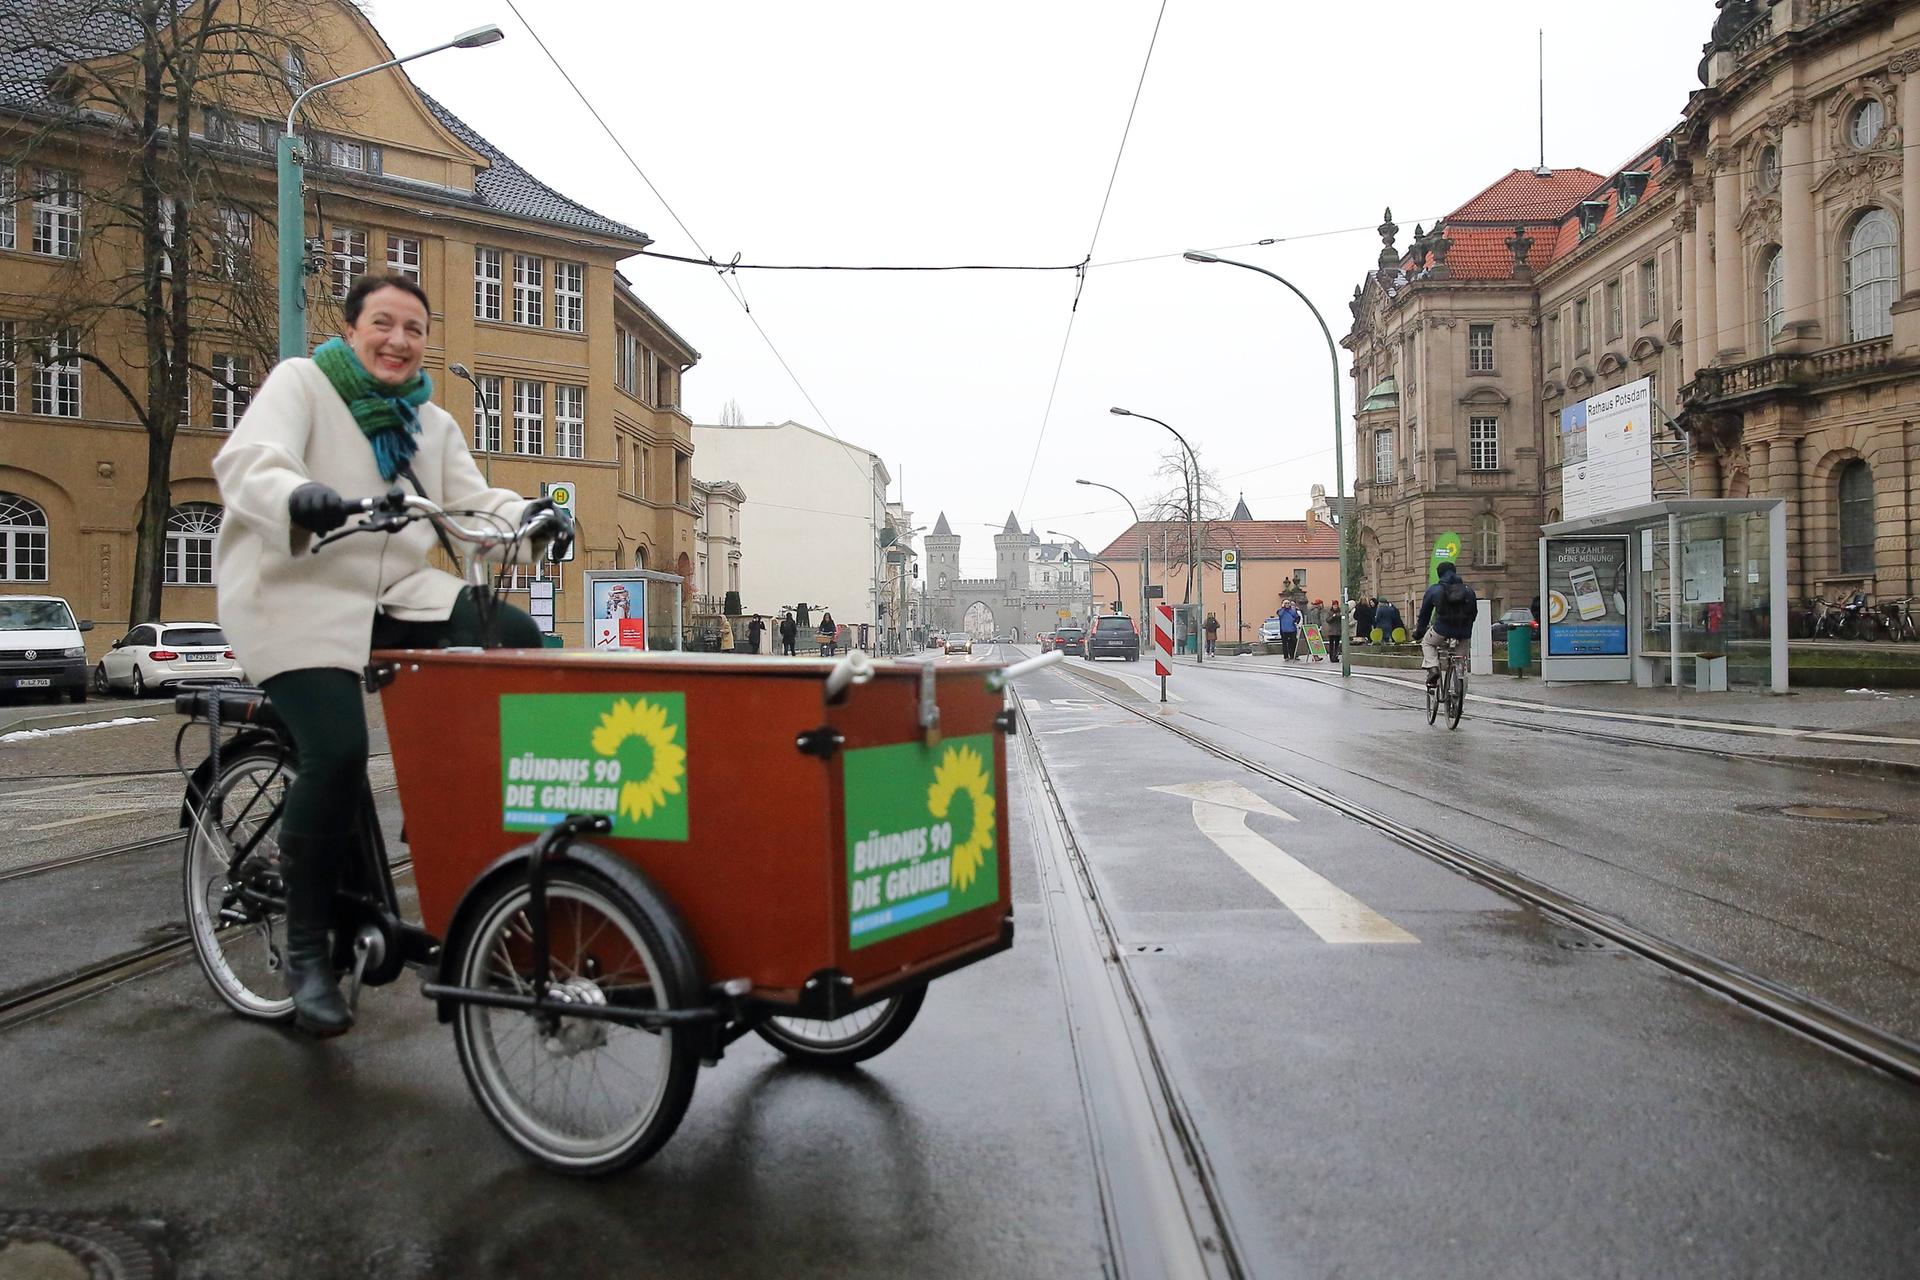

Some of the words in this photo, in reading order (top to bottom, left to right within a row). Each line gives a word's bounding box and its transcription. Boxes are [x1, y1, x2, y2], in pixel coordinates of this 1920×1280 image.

[1588, 399, 1613, 416] Rathaus
[1615, 388, 1648, 408] Potsdam
[556, 491, 565, 501] H
[1558, 554, 1578, 562] DEINE
[1579, 554, 1614, 562] MEINUNG!
[1565, 546, 1580, 554] HIER
[508, 752, 590, 781] BÜNDNIS
[593, 759, 621, 783] 90
[505, 784, 536, 807] DIE
[540, 781, 619, 811] GRÜNEN
[854, 827, 928, 873] BÜNDNIS
[930, 821, 952, 854] 90
[851, 874, 882, 912] DIE
[886, 856, 950, 902] GRÜNEN
